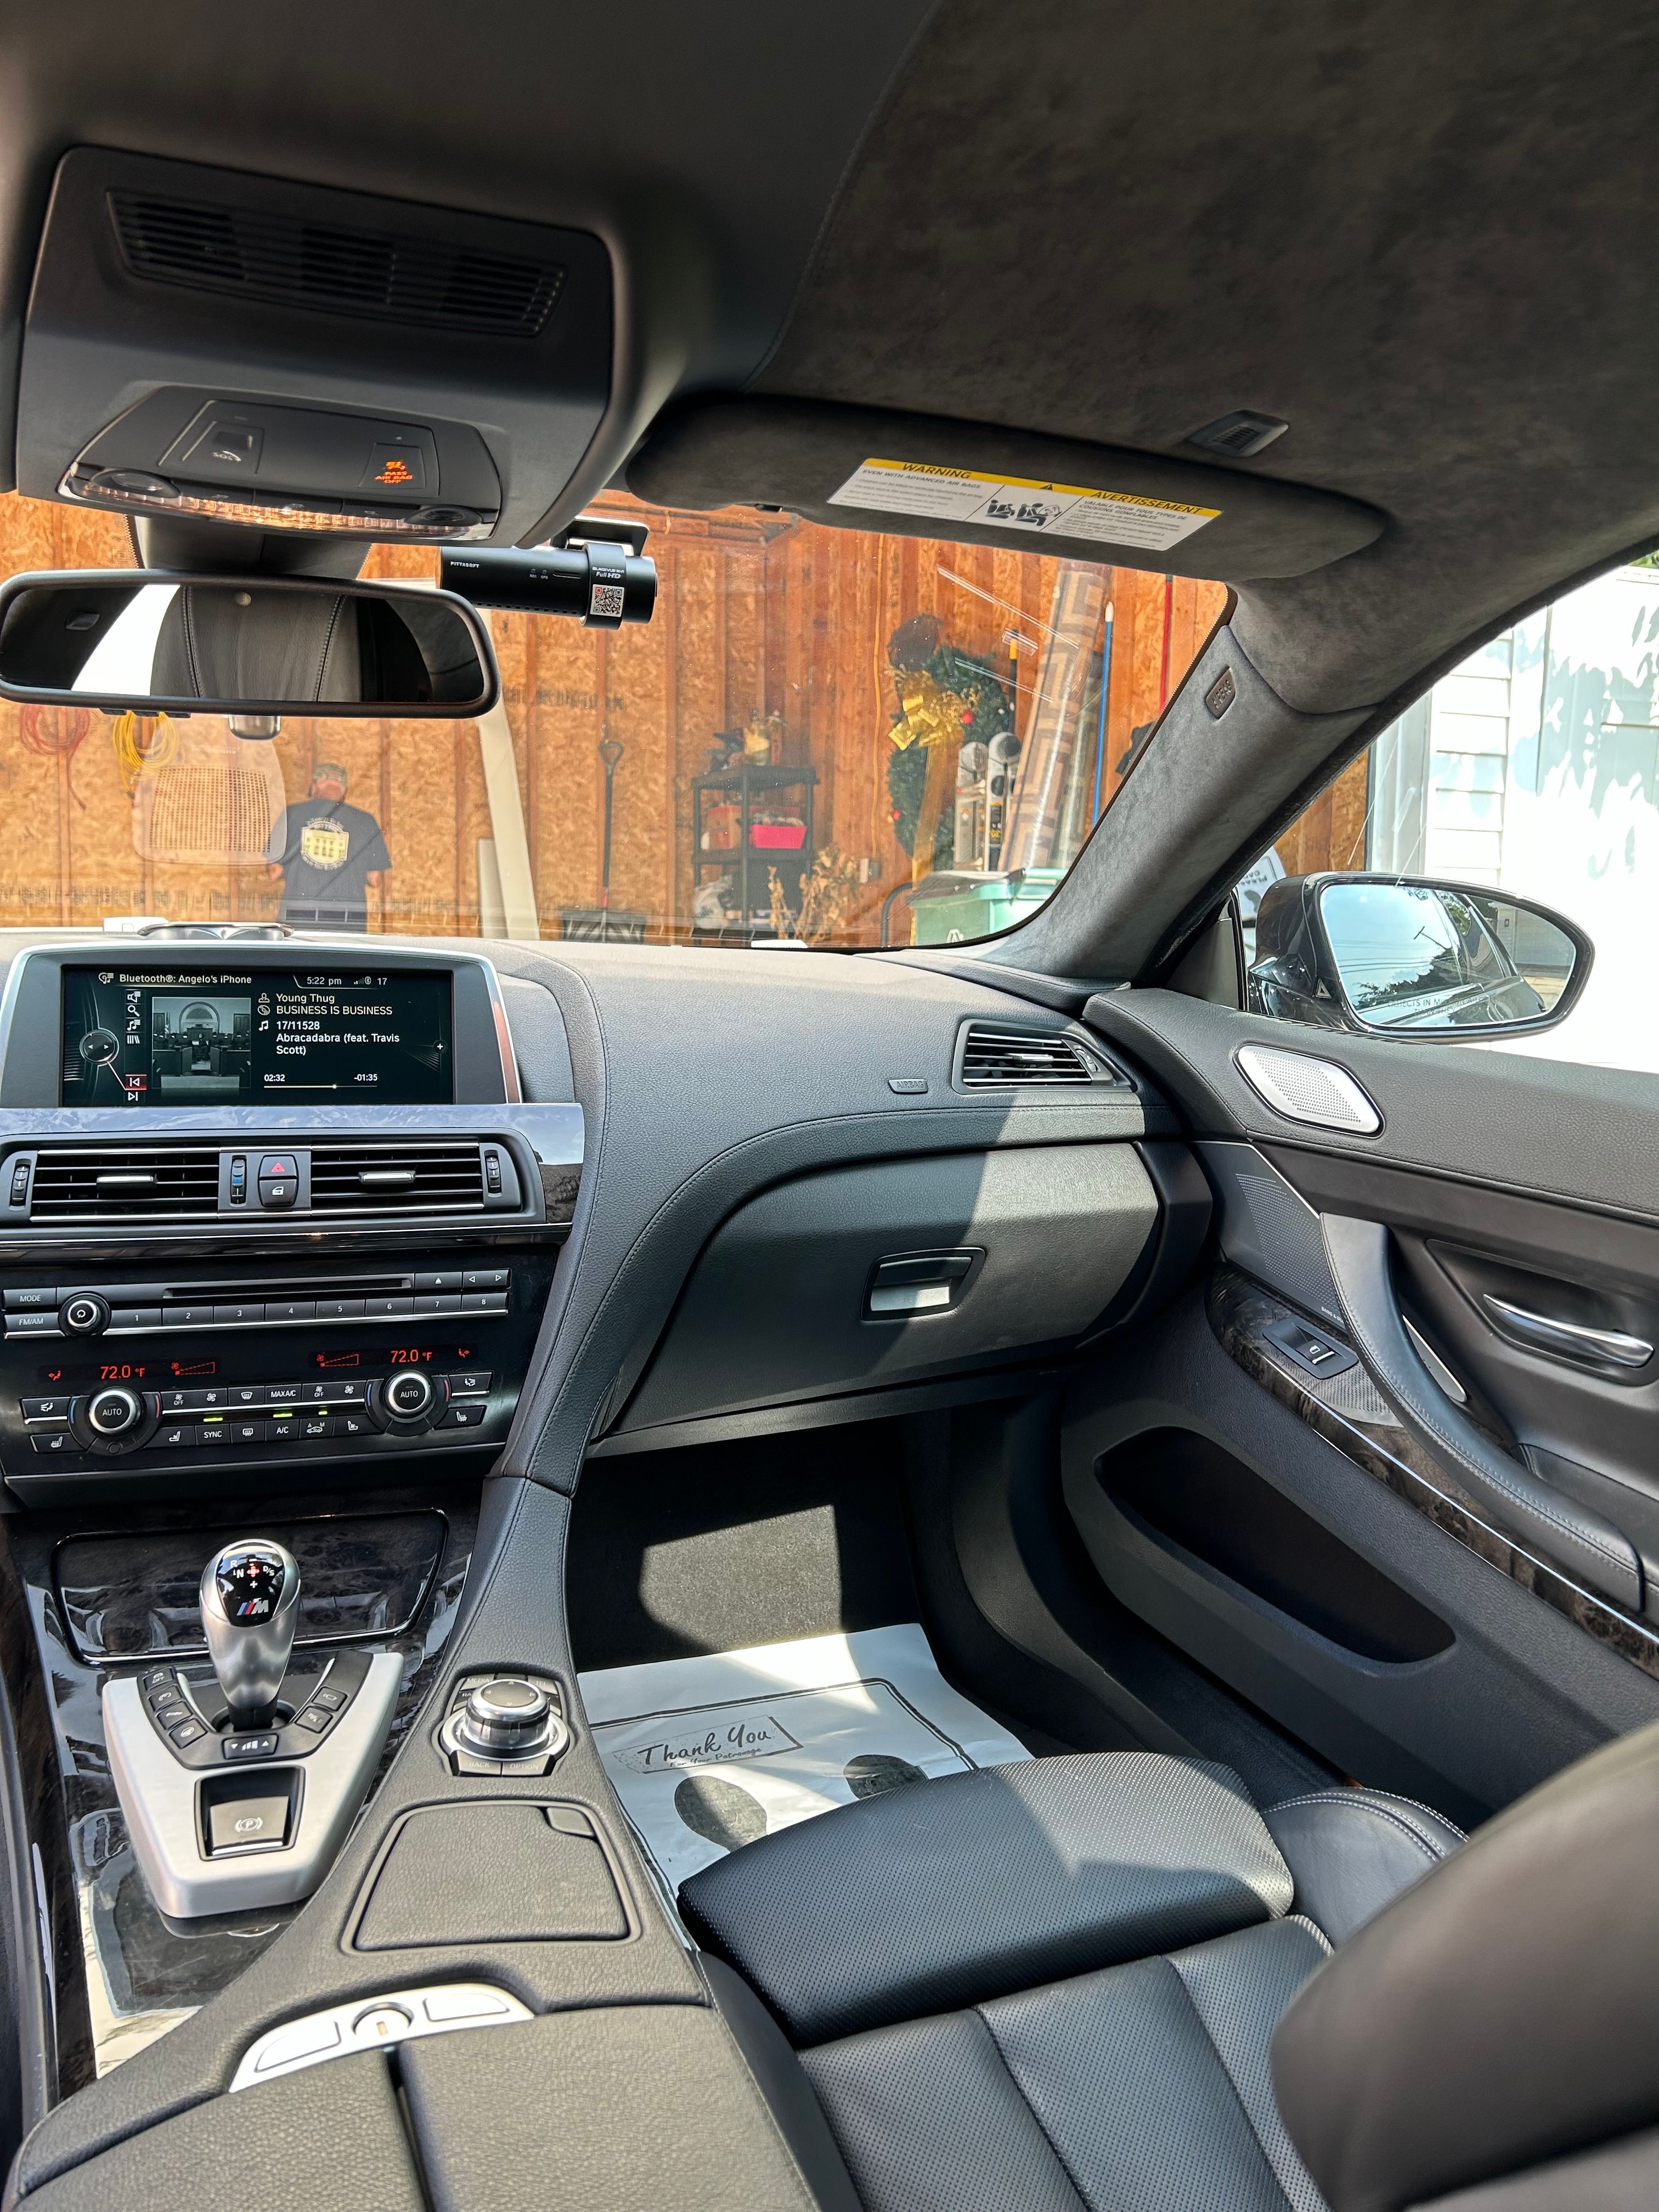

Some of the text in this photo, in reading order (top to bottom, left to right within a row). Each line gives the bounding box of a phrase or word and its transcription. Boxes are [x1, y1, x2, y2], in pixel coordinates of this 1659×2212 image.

[902, 463, 972, 479] WARNING
[906, 475, 945, 484] ADVANCED
[1084, 500, 1113, 509] VALABLE
[1091, 491, 1203, 514] AVERTISSEMENT
[1079, 504, 1158, 520] COUSSINS GONFLABLES
[1212, 680, 1232, 709] AIRBAG
[178, 975, 218, 984] Angelo's
[220, 975, 252, 984] iPhone
[307, 977, 342, 986] 5:22 pm
[276, 993, 335, 1004] Young Thug
[276, 1006, 393, 1015] BUSINESS IS BUSINESS
[276, 1021, 320, 1030] 17/11528
[276, 1034, 399, 1043] Abracadabra (feat. Travis
[276, 1046, 306, 1056] Scott)
[896, 1081, 924, 1089] AIRBAG
[19, 1318, 43, 1326] FM/AM
[391, 1349, 419, 1363] 72.0
[100, 1365, 131, 1379] 72.0
[400, 1390, 419, 1398] AUTO
[204, 1430, 222, 1438] SYNC
[276, 1426, 289, 1435] A/C
[230, 1560, 238, 1568] R
[236, 1568, 244, 1578] N
[263, 1565, 275, 1576] D/S
[637, 1724, 772, 1765] Thank You
[715, 1747, 763, 1760] Patronage
